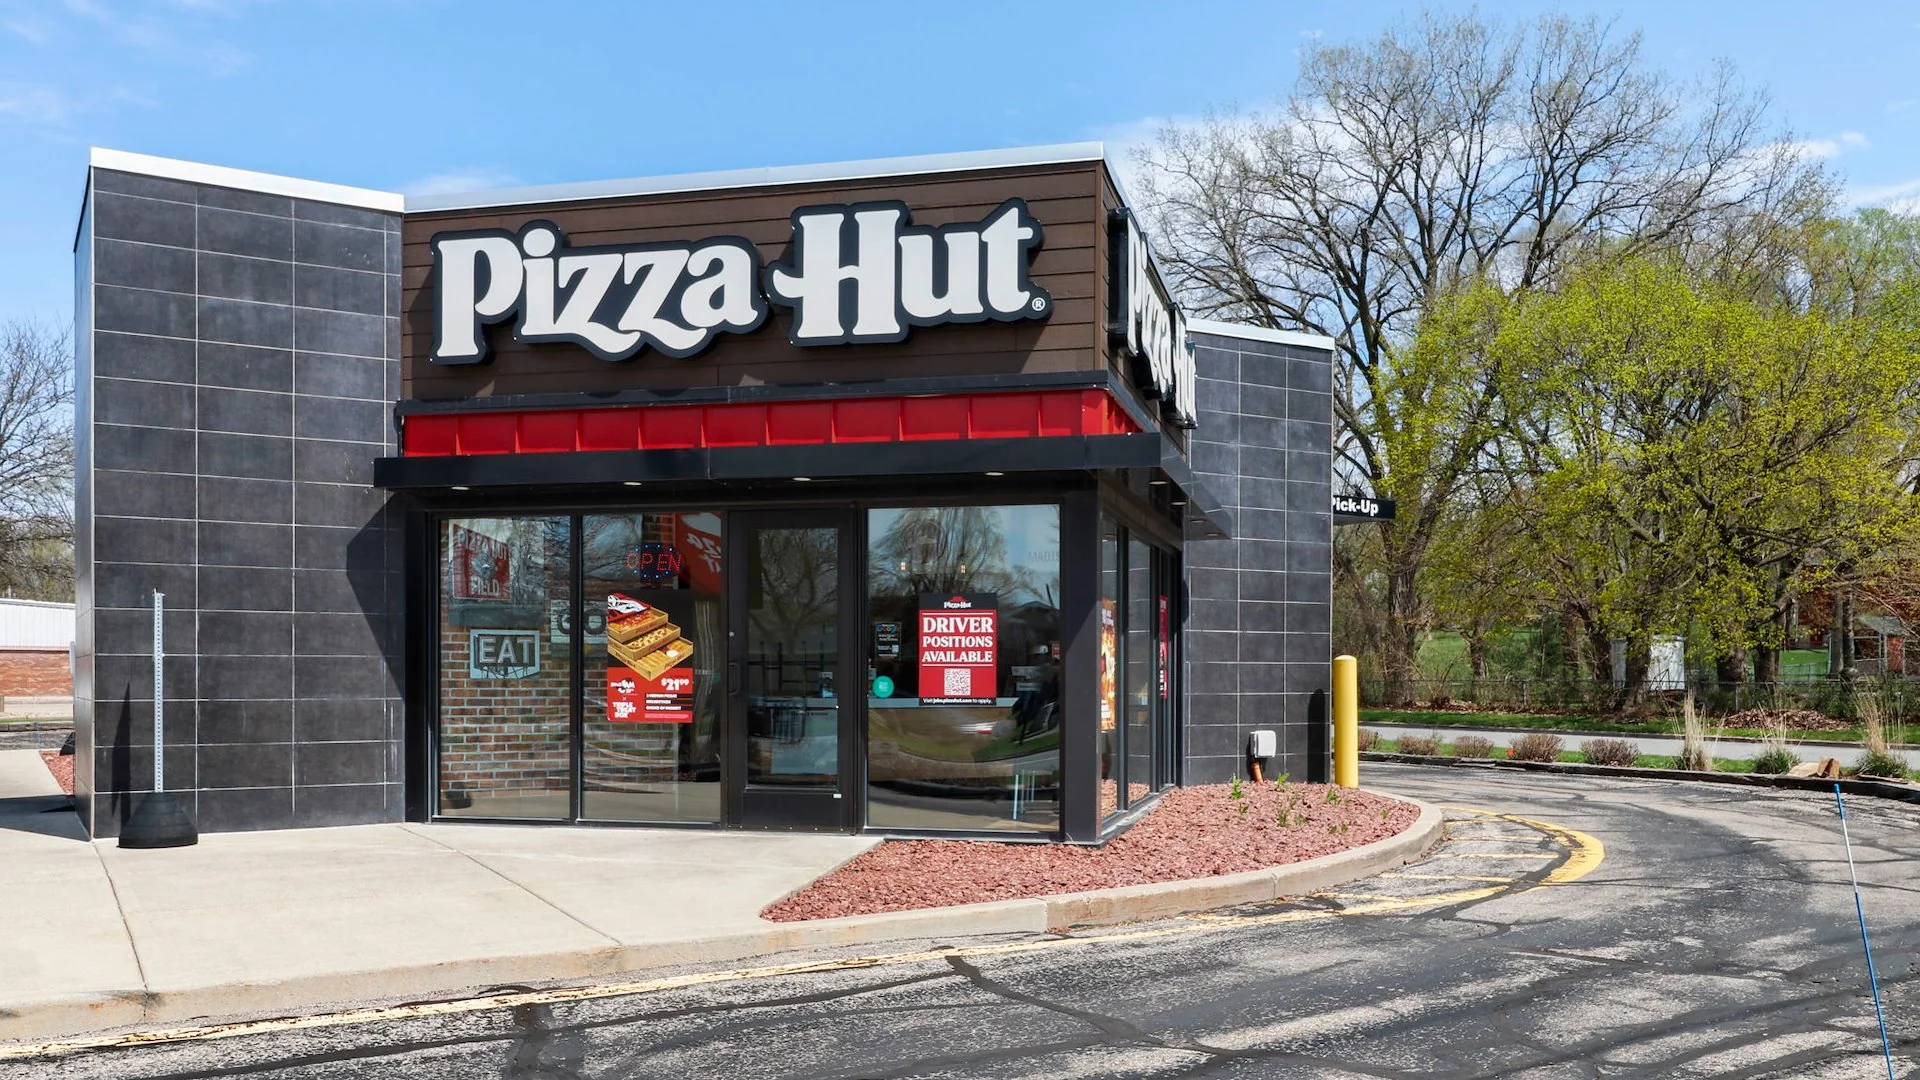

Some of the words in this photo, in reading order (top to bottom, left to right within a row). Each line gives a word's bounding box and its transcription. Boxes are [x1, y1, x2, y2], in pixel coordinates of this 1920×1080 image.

[436, 227, 758, 355] Pizza
[772, 206, 1034, 338] Hut
[1127, 216, 1173, 396] Pizza
[625, 551, 681, 572] OPEN
[922, 616, 994, 633] DRIVER
[479, 636, 533, 664] EAT
[922, 635, 993, 648] POSITIONS
[922, 650, 993, 663] AVAILABLE
